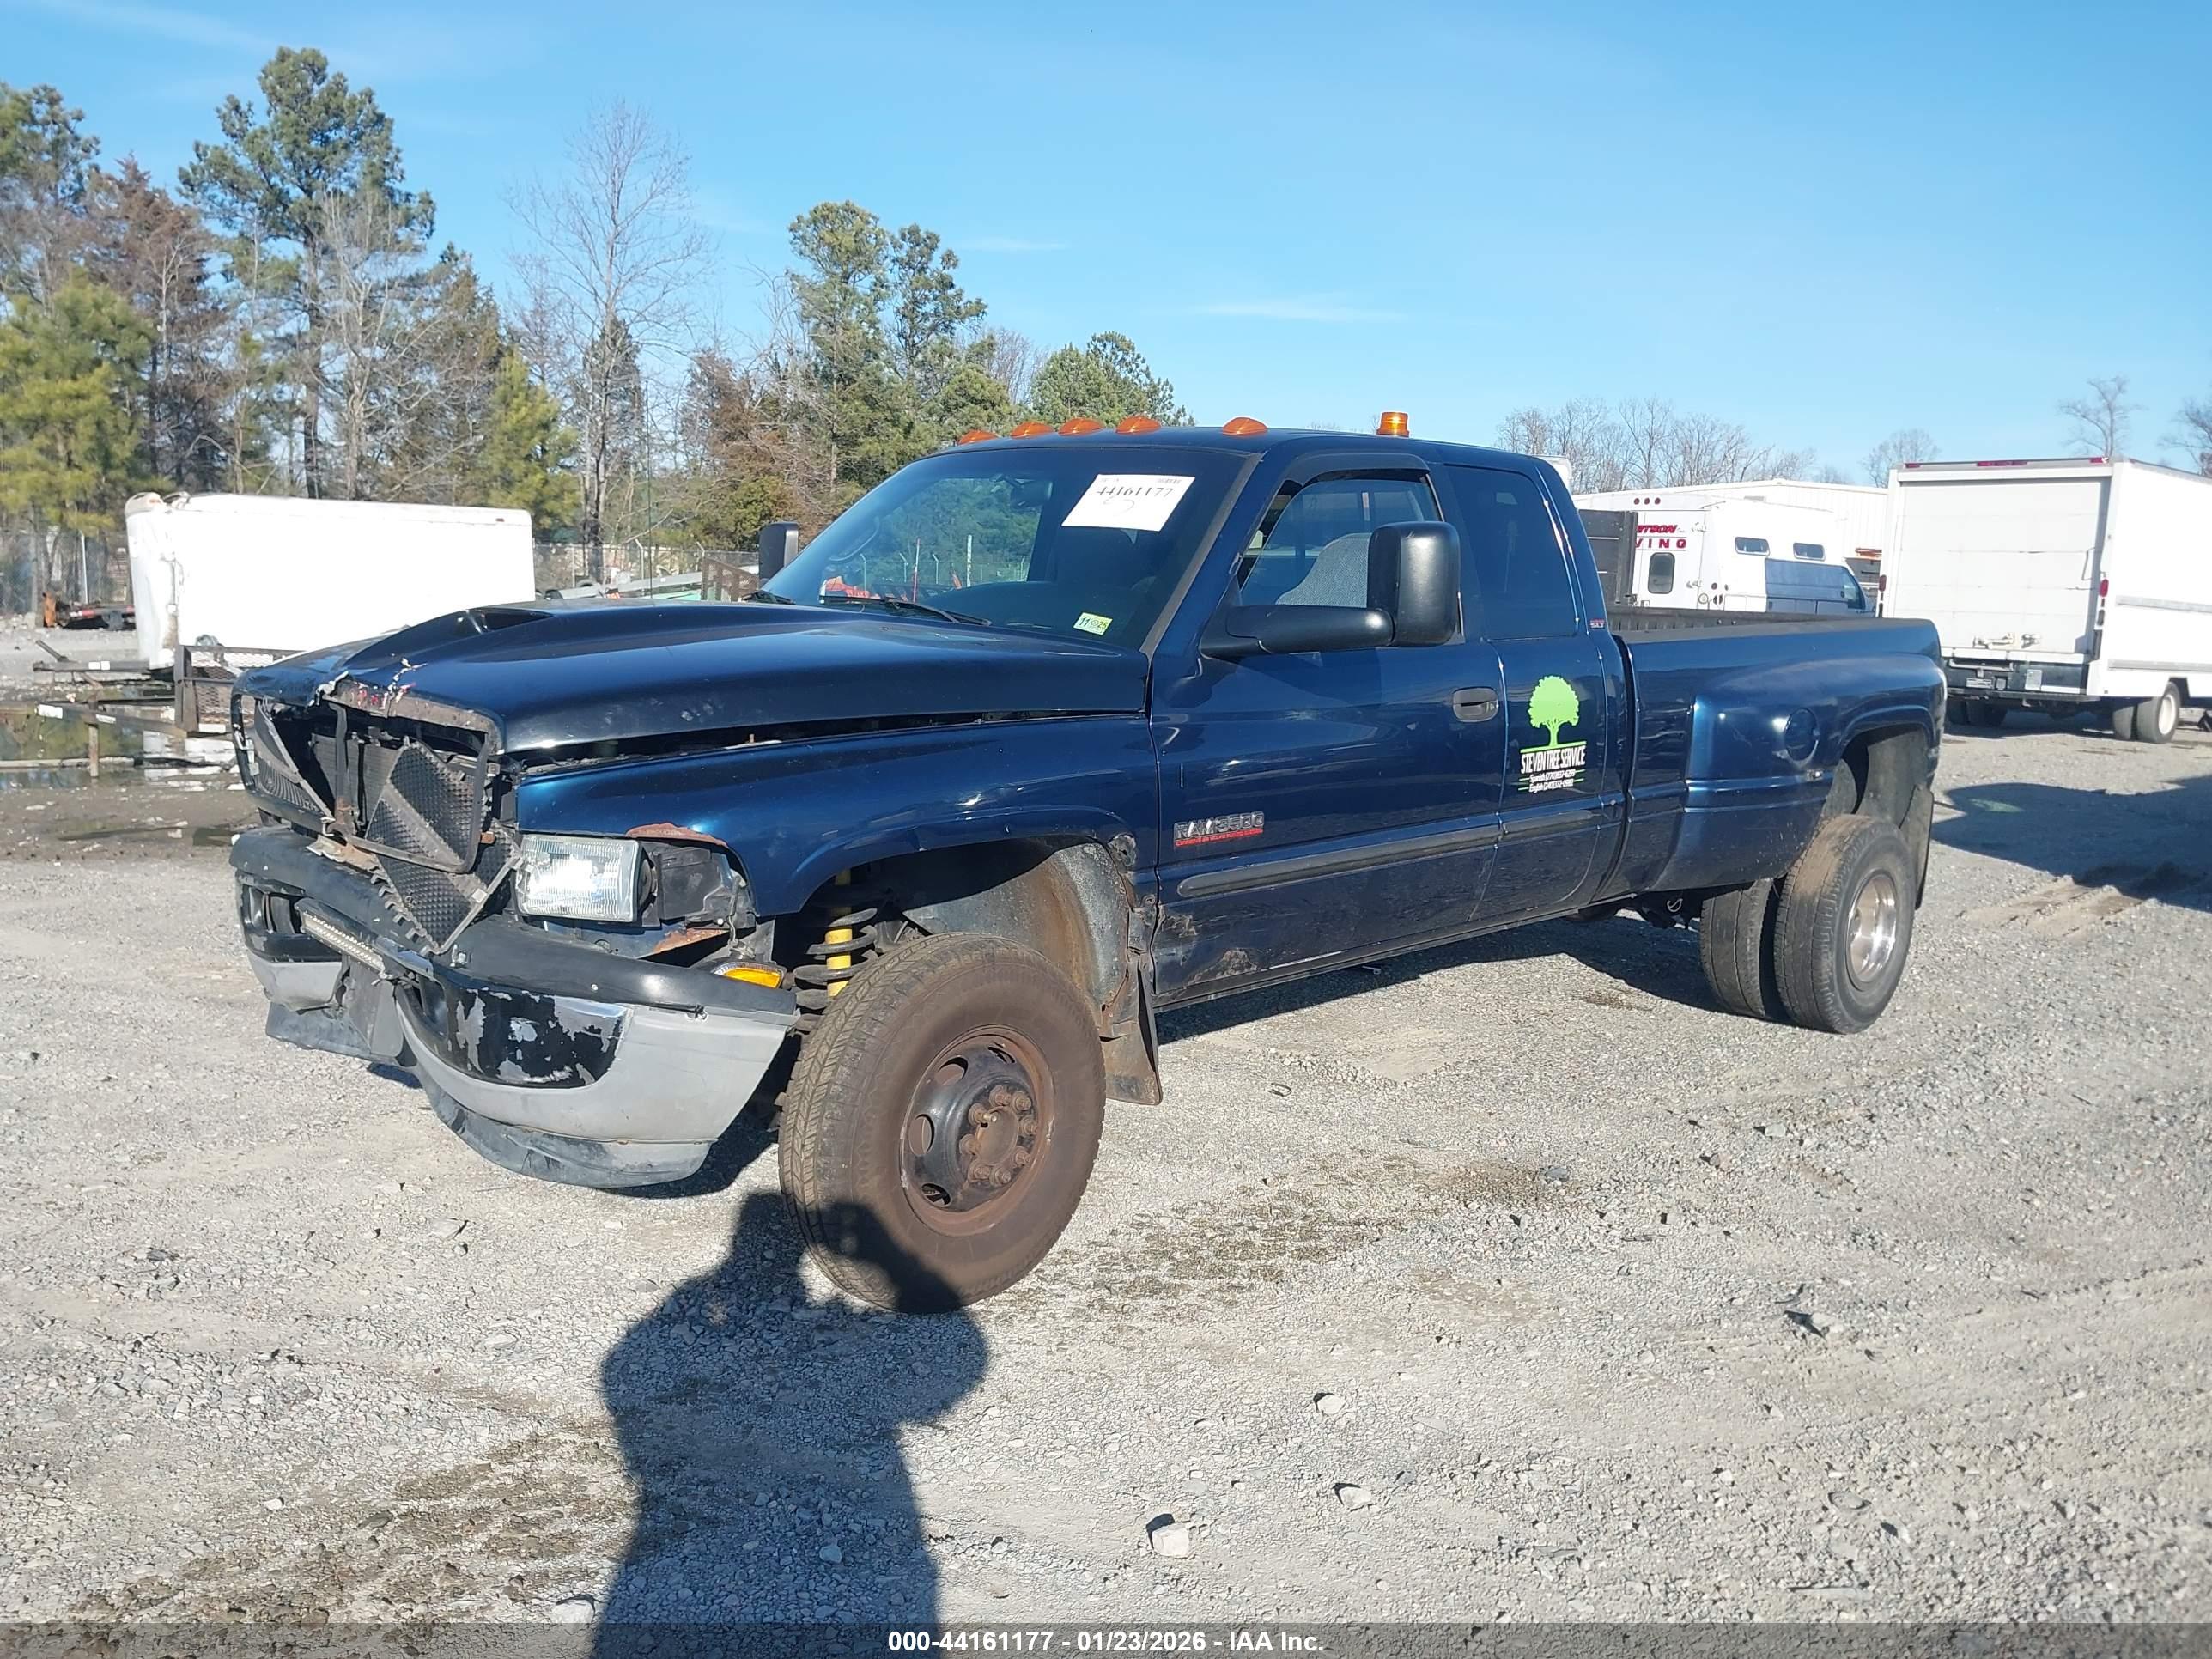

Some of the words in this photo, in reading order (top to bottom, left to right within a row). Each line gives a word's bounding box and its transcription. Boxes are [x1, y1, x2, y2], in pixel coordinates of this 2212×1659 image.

[1097, 486, 1175, 498] 44161177
[1079, 617, 1091, 626] 11
[1521, 751, 1547, 774] STEVEN
[1547, 749, 1561, 769] TREE
[1560, 745, 1586, 768] SERVICE
[1174, 819, 1215, 839] RAM
